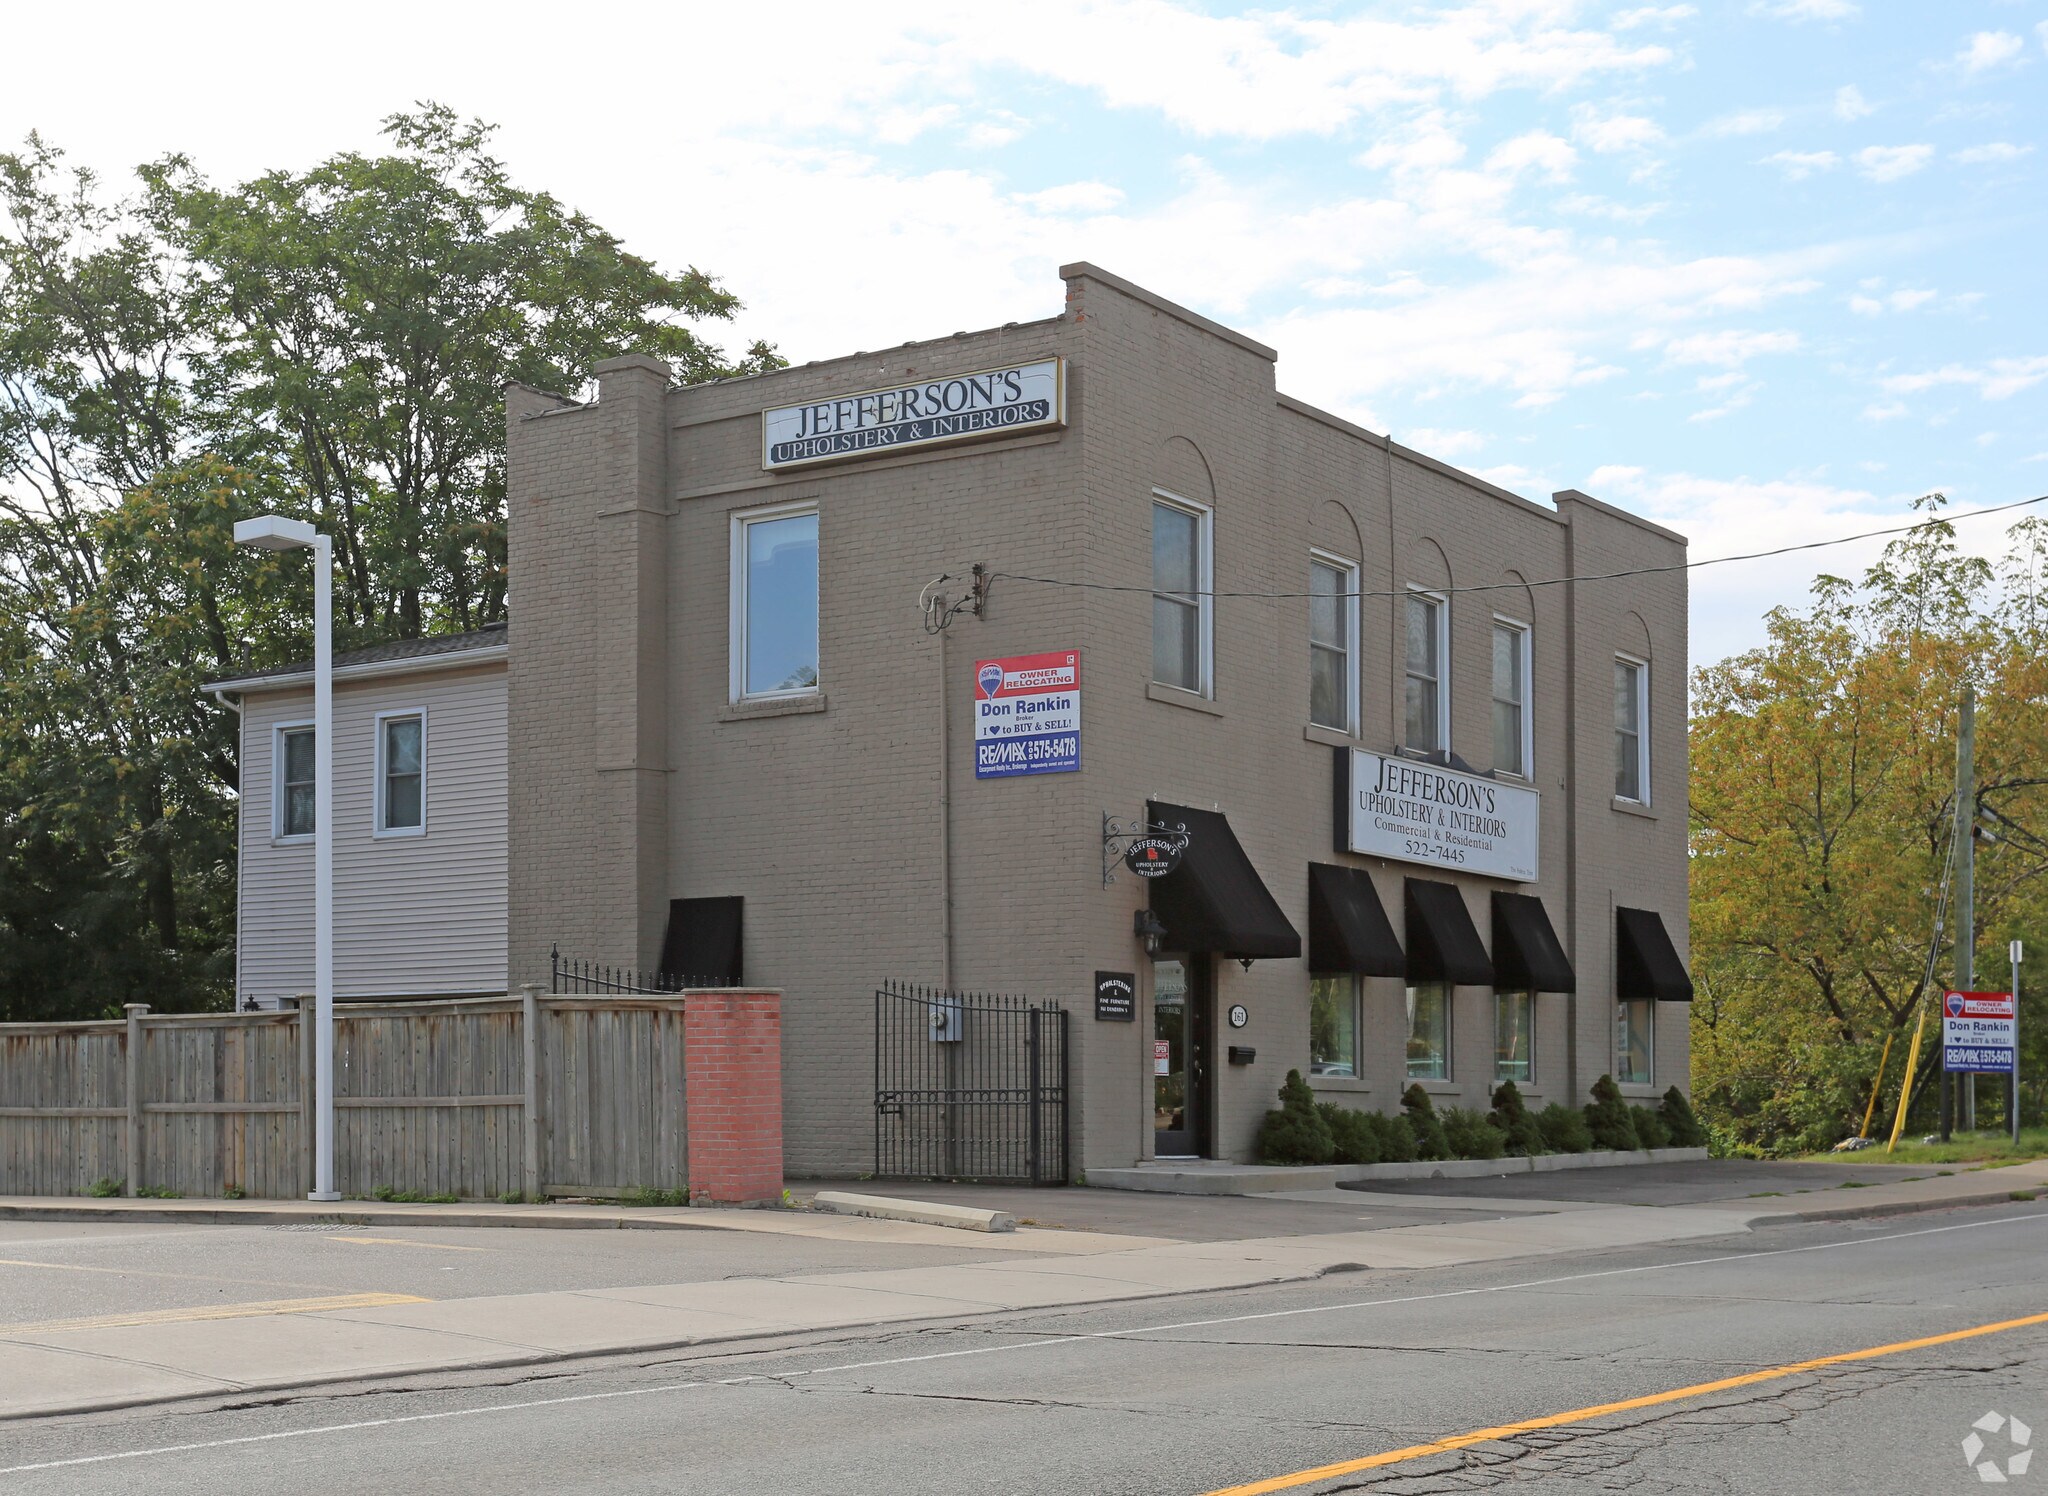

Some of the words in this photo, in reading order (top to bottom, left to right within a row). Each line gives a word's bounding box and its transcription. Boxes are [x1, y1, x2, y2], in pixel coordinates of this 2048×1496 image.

[795, 369, 1022, 438] JEFFERSON'S
[776, 425, 903, 461] UPHOLSTERY
[909, 423, 922, 439] &
[931, 401, 1045, 436] INTERIORS
[1006, 675, 1072, 688] RELOCATING
[1019, 669, 1058, 679] OWNER
[981, 703, 1011, 717] Don
[1016, 696, 1071, 714] Rankin
[1002, 726, 1012, 734] to
[1014, 723, 1032, 733] BUY
[1034, 722, 1042, 731] &
[1044, 719, 1072, 730] SELL!
[979, 741, 1027, 765] RE/MAX
[1033, 737, 1076, 760] 575-5478
[1374, 756, 1495, 813] JEFFERSON'S
[1359, 790, 1434, 824] UPHOLSTERY
[1437, 808, 1445, 827] &
[1450, 810, 1507, 839] INTERIORS
[1374, 816, 1431, 839] Commercial
[1434, 830, 1441, 841] &
[1445, 831, 1493, 851] Residential
[1129, 839, 1177, 856] JEFFERSON'S
[1405, 840, 1465, 863] 522-7445
[1137, 869, 1168, 877] INTERIORS
[1233, 1011, 1244, 1022] 161
[1949, 1021, 1970, 1030] Don
[1973, 1021, 2010, 1032] Rankin
[1946, 1048, 1980, 1063] RE/MAX
